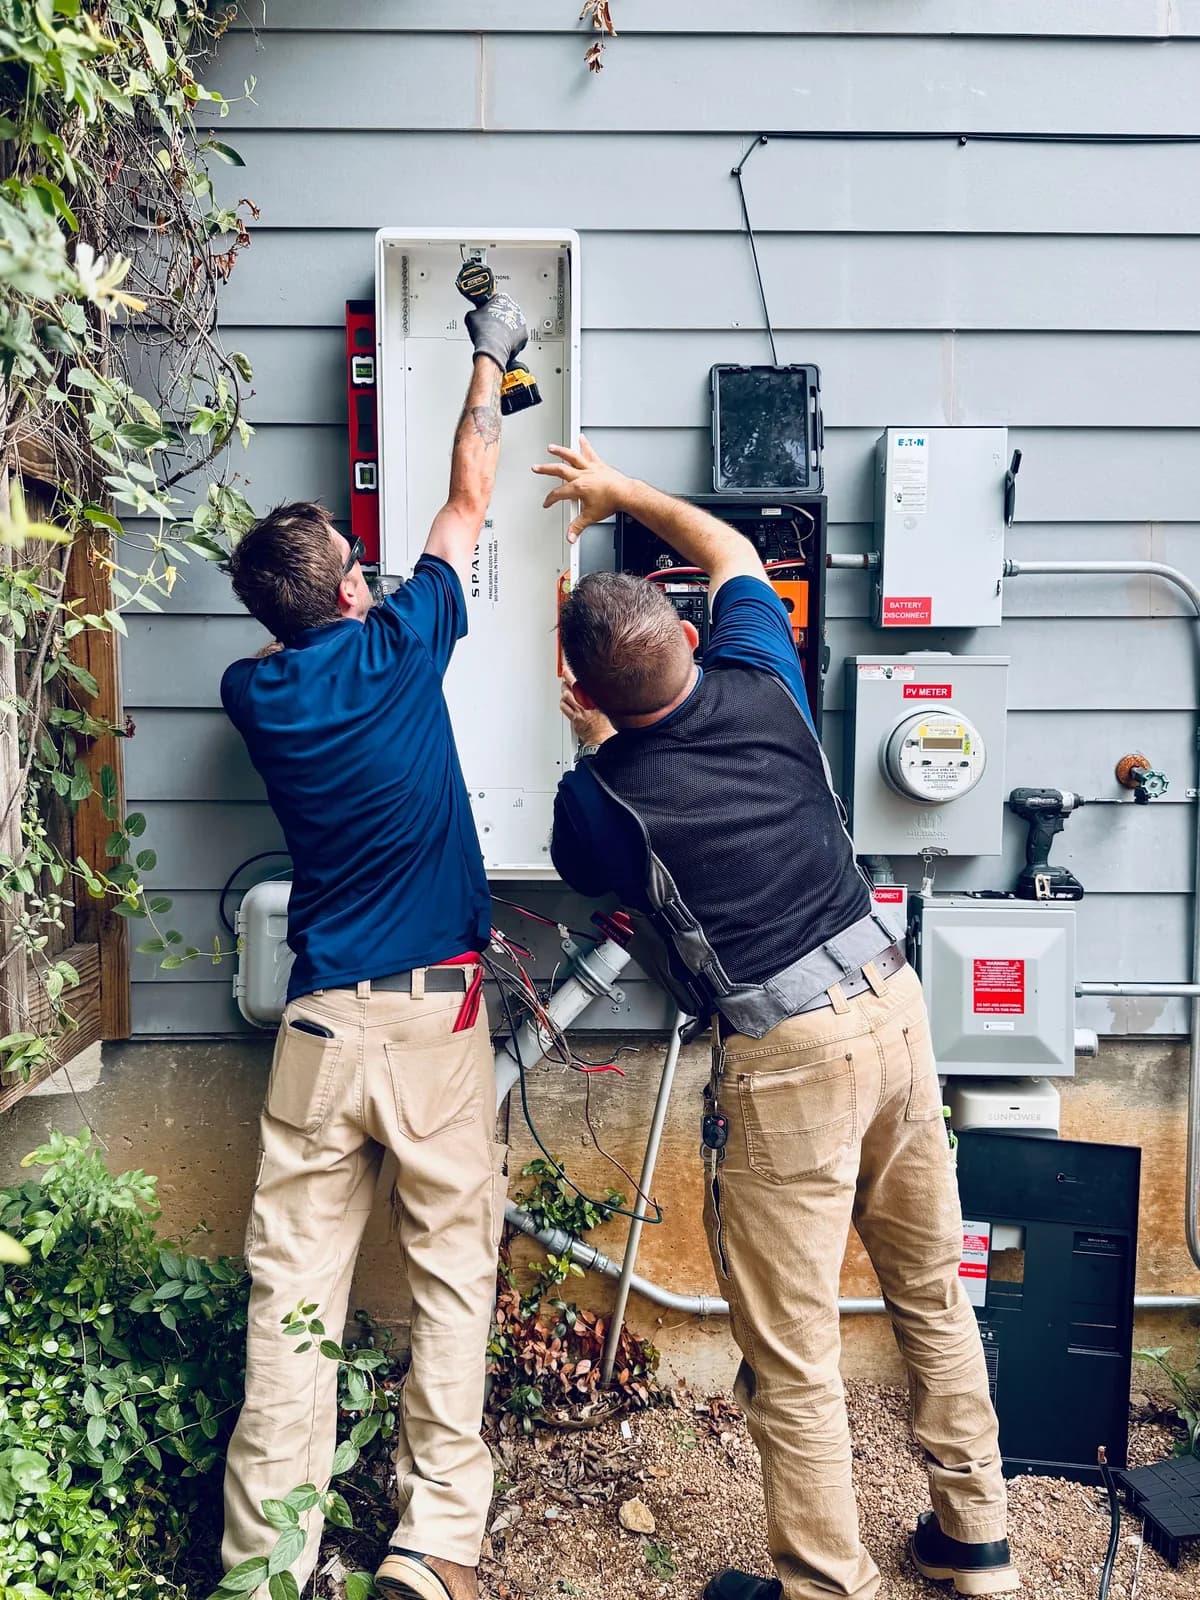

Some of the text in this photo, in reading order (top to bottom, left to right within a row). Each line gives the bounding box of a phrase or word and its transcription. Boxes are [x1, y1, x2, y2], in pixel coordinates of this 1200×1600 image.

[889, 601, 922, 609] BATTERY
[883, 611, 929, 619] DISCONNECT
[905, 687, 948, 696] PV METER
[987, 1112, 1041, 1121] SUNPOWER
